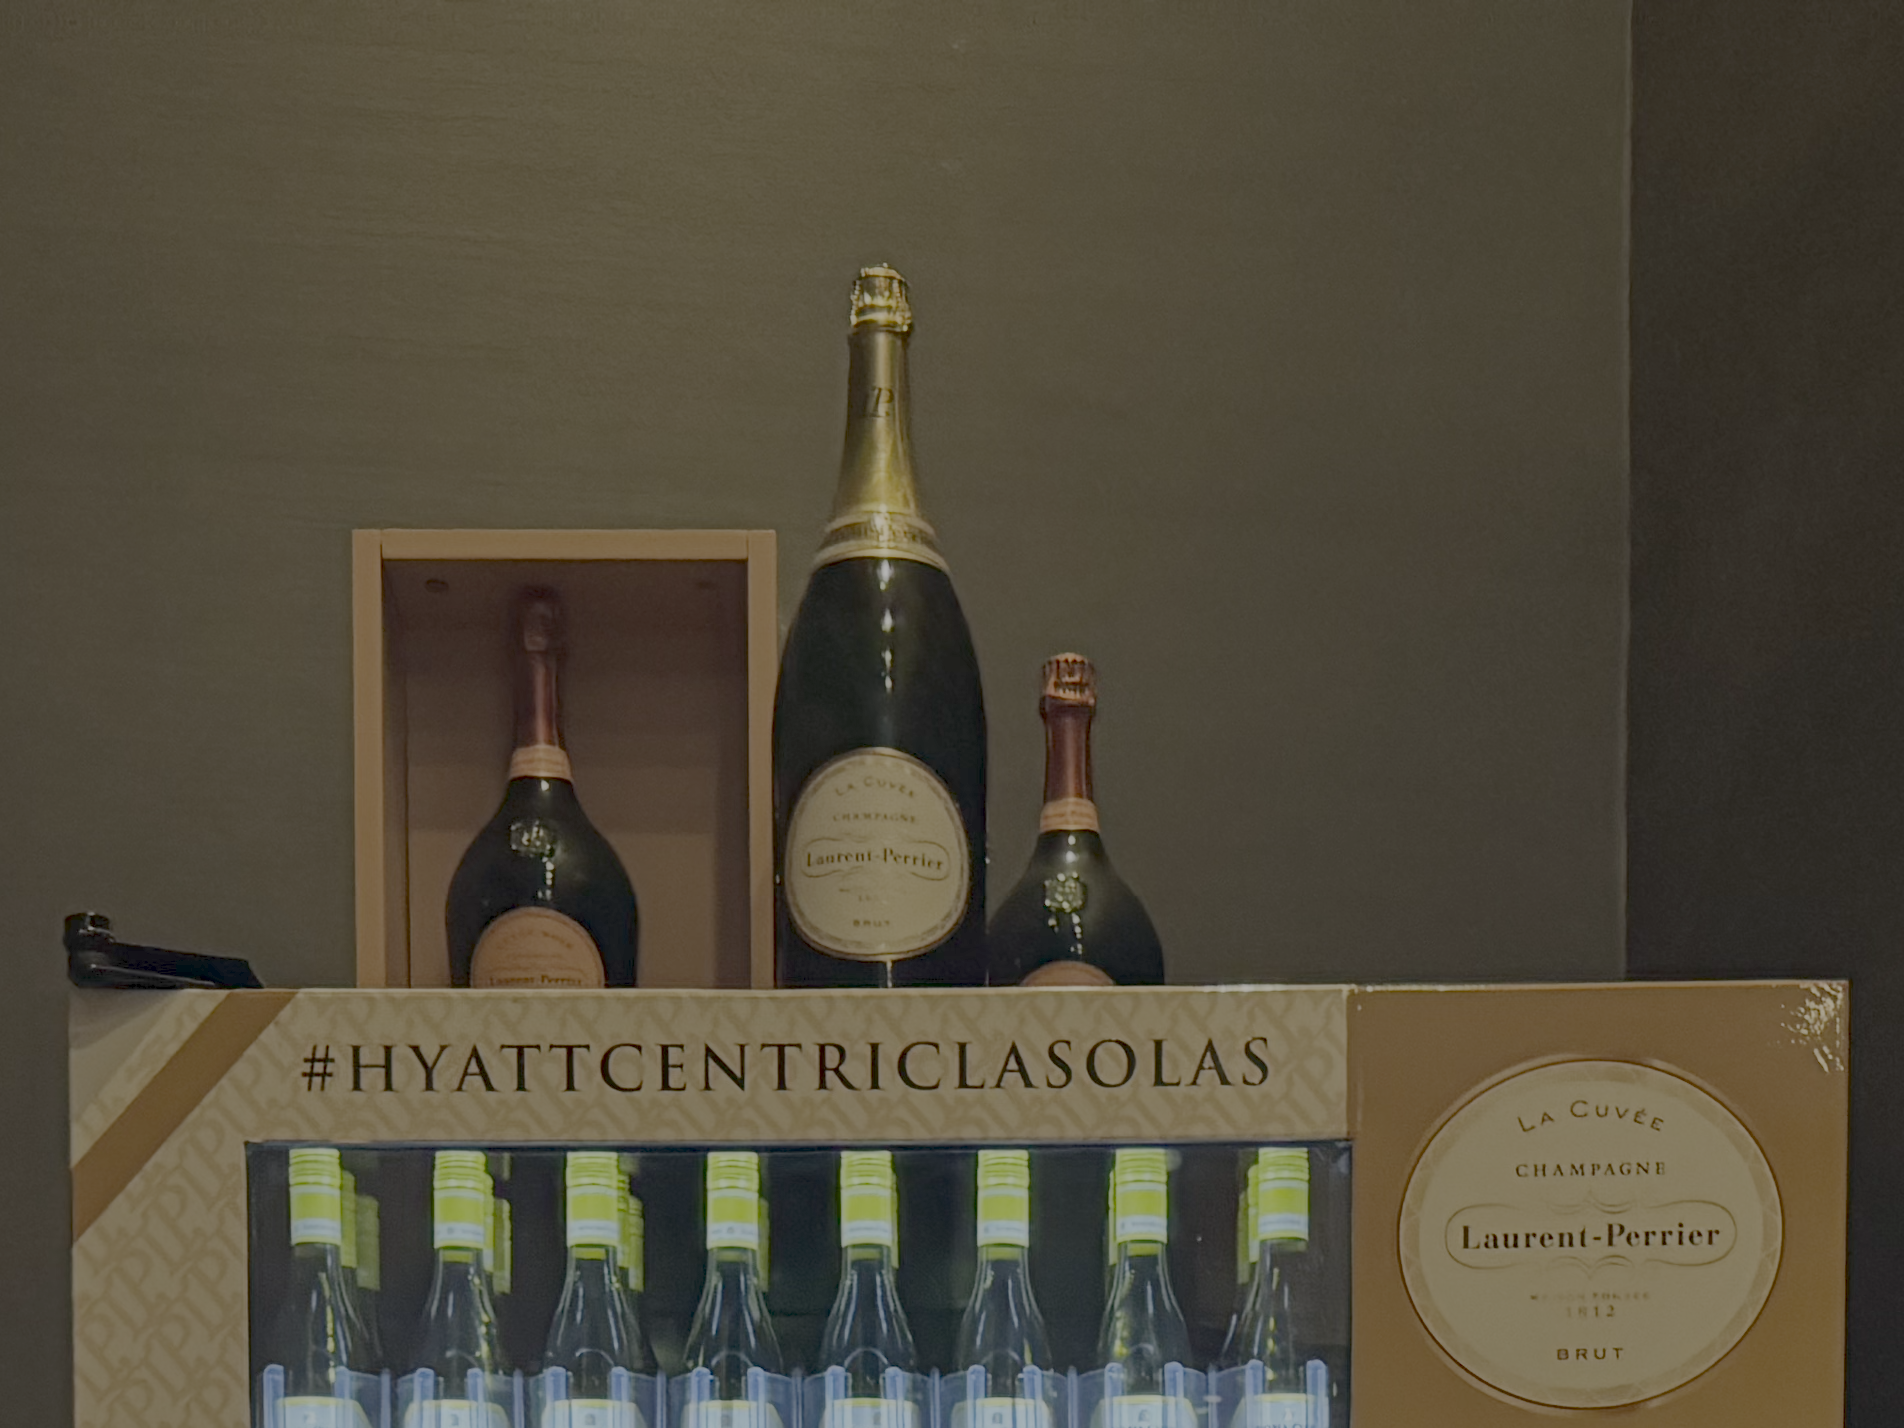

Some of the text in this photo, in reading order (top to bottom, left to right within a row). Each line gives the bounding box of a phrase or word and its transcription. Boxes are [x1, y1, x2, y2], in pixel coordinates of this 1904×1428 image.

[806, 847, 945, 871] Laurent-Perrier
[300, 1035, 1270, 1094] #HYATTCENTRICLASOLAS
[1517, 1099, 1665, 1133] LA CUVÉE
[1515, 1160, 1666, 1179] CHAMPAGNE
[1462, 1222, 1720, 1250] Laurent-Perrier
[1556, 1347, 1624, 1361] BRUT
